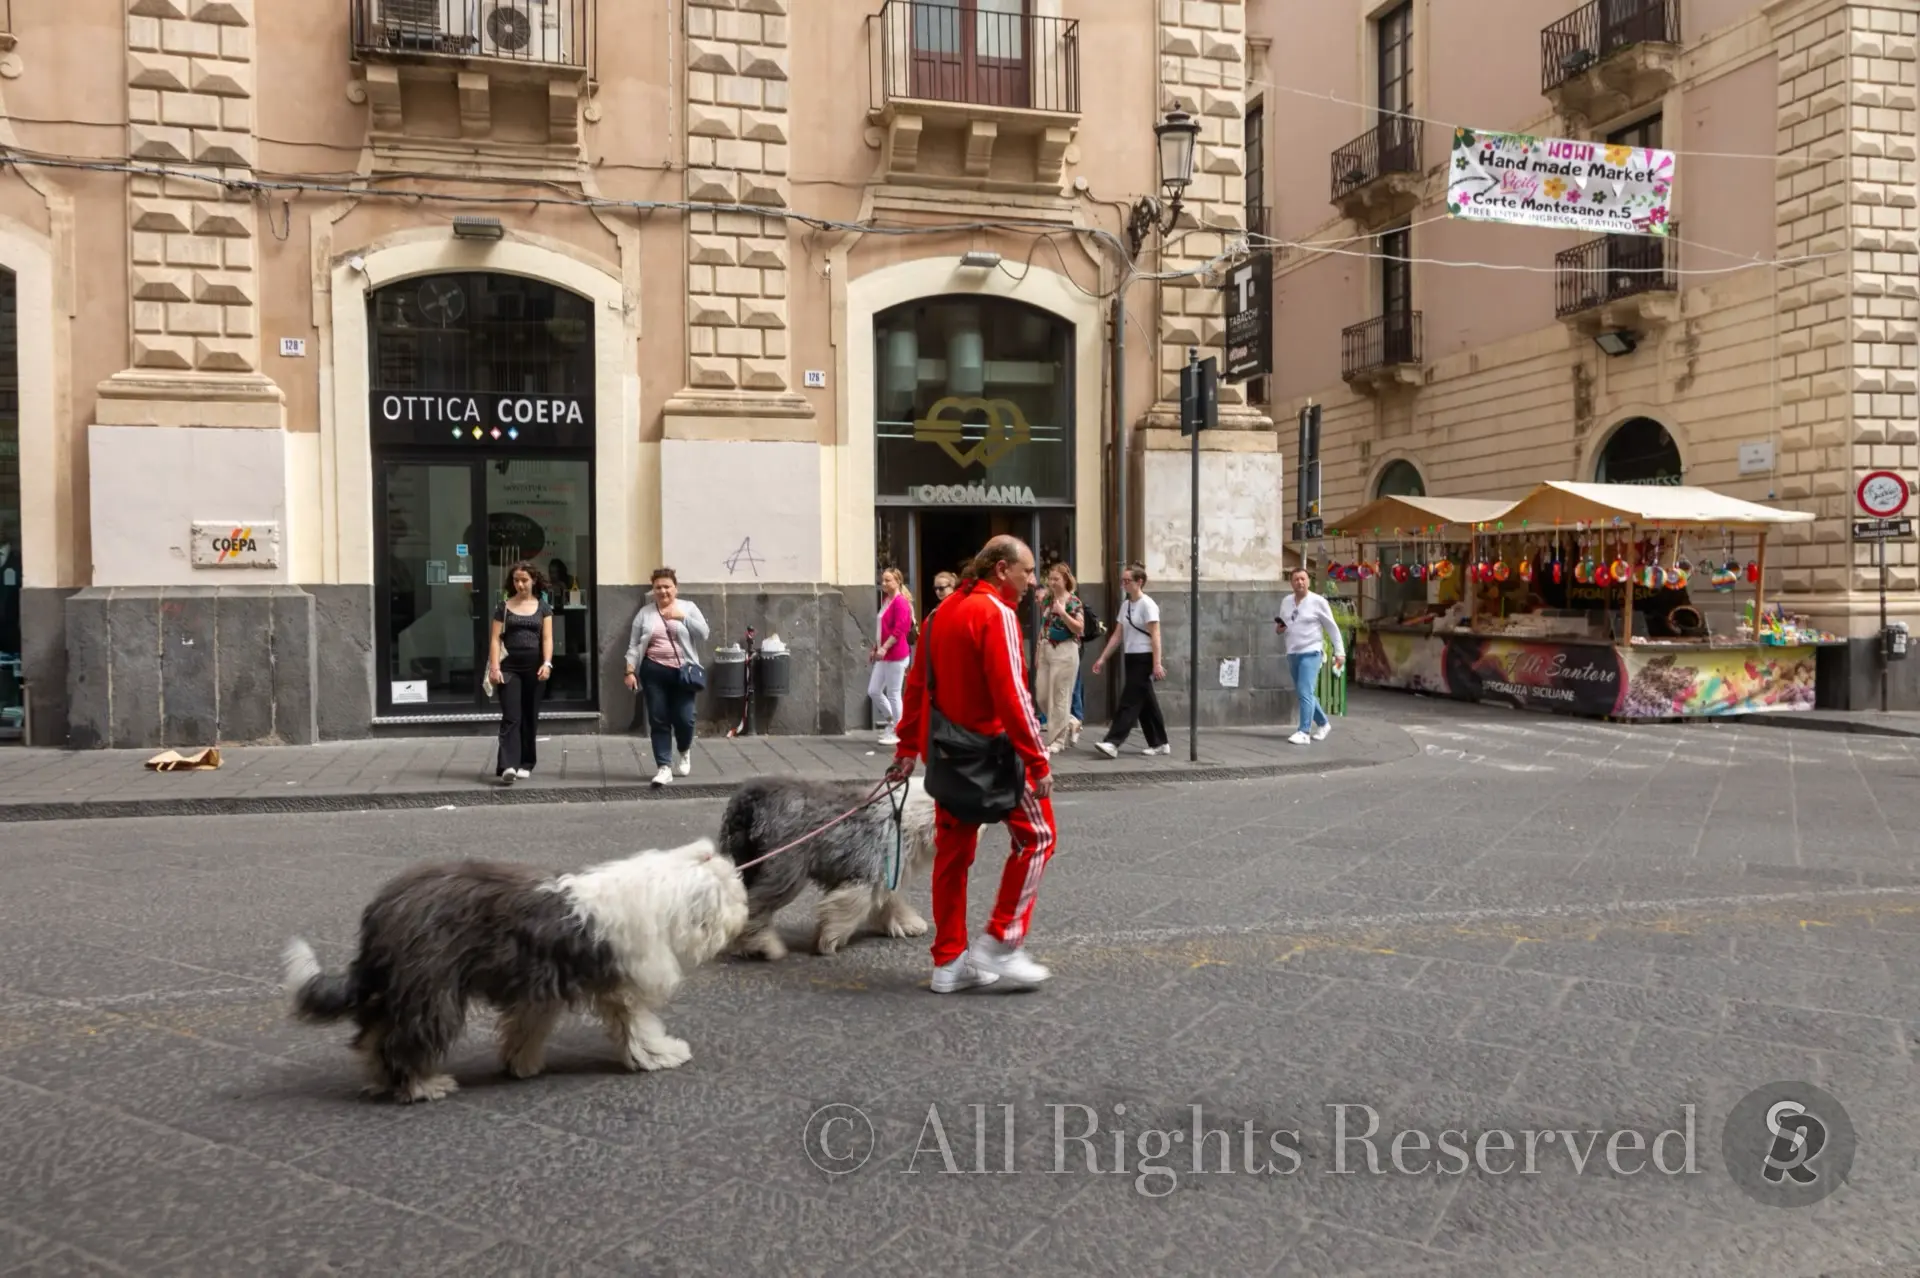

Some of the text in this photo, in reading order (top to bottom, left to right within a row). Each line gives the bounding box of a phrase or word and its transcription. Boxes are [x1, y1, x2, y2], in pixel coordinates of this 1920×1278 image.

[1548, 142, 1594, 162] WOW!
[1479, 150, 1656, 183] Hand made Market
[1500, 170, 1540, 199] Sicily
[1468, 206, 1491, 217] FREE
[1472, 192, 1632, 219] Corte Montesano n.5
[1229, 307, 1258, 328] TABACCHI
[382, 395, 584, 424] OTTICA COEPA
[918, 484, 1036, 505] OROMANIA
[212, 538, 257, 552] COEPA
[1545, 653, 1615, 683] Santoro
[1532, 687, 1576, 702] SICILIANE
